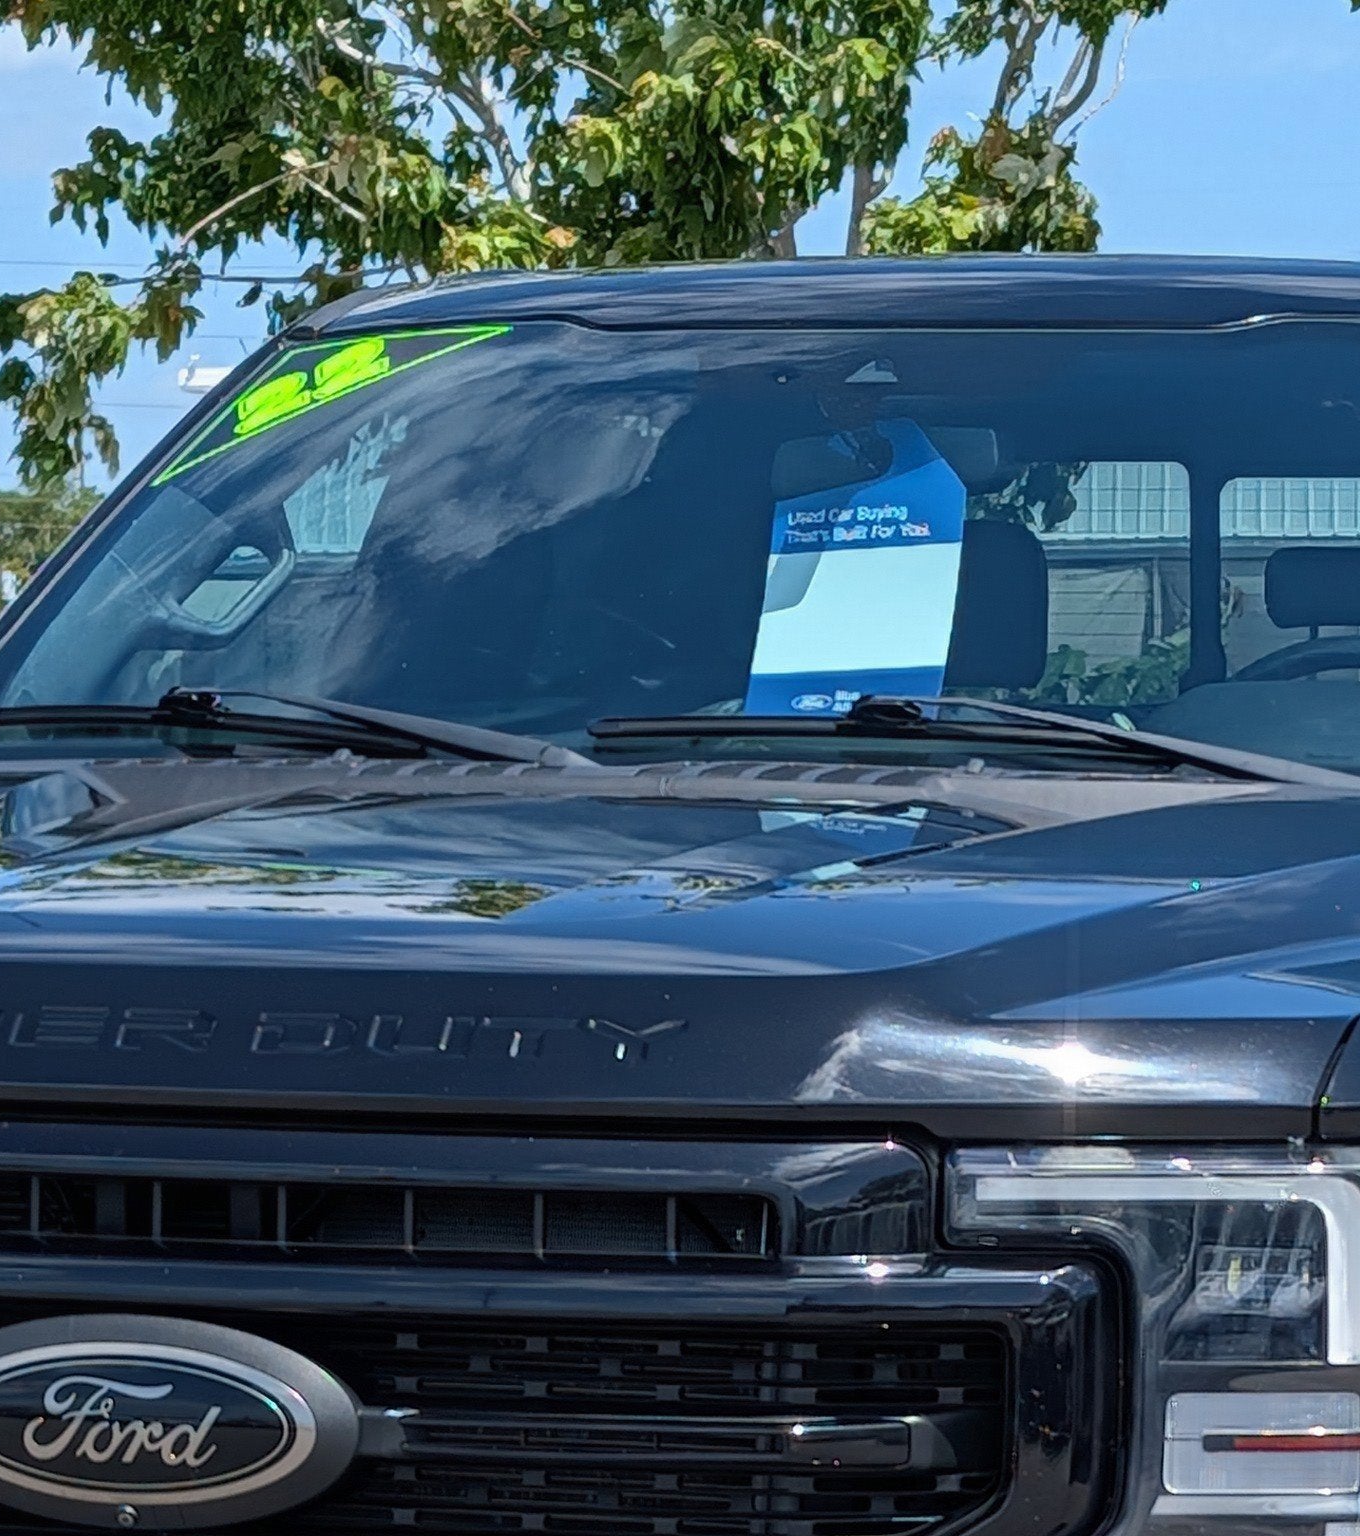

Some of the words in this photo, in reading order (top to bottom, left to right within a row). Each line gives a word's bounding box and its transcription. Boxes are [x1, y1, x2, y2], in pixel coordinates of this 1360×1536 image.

[787, 508, 825, 526] Used
[828, 507, 854, 522] Car
[856, 504, 908, 523] Buying
[870, 523, 896, 539] For
[250, 1013, 689, 1060] DUTY
[22, 1374, 223, 1469] Ford
